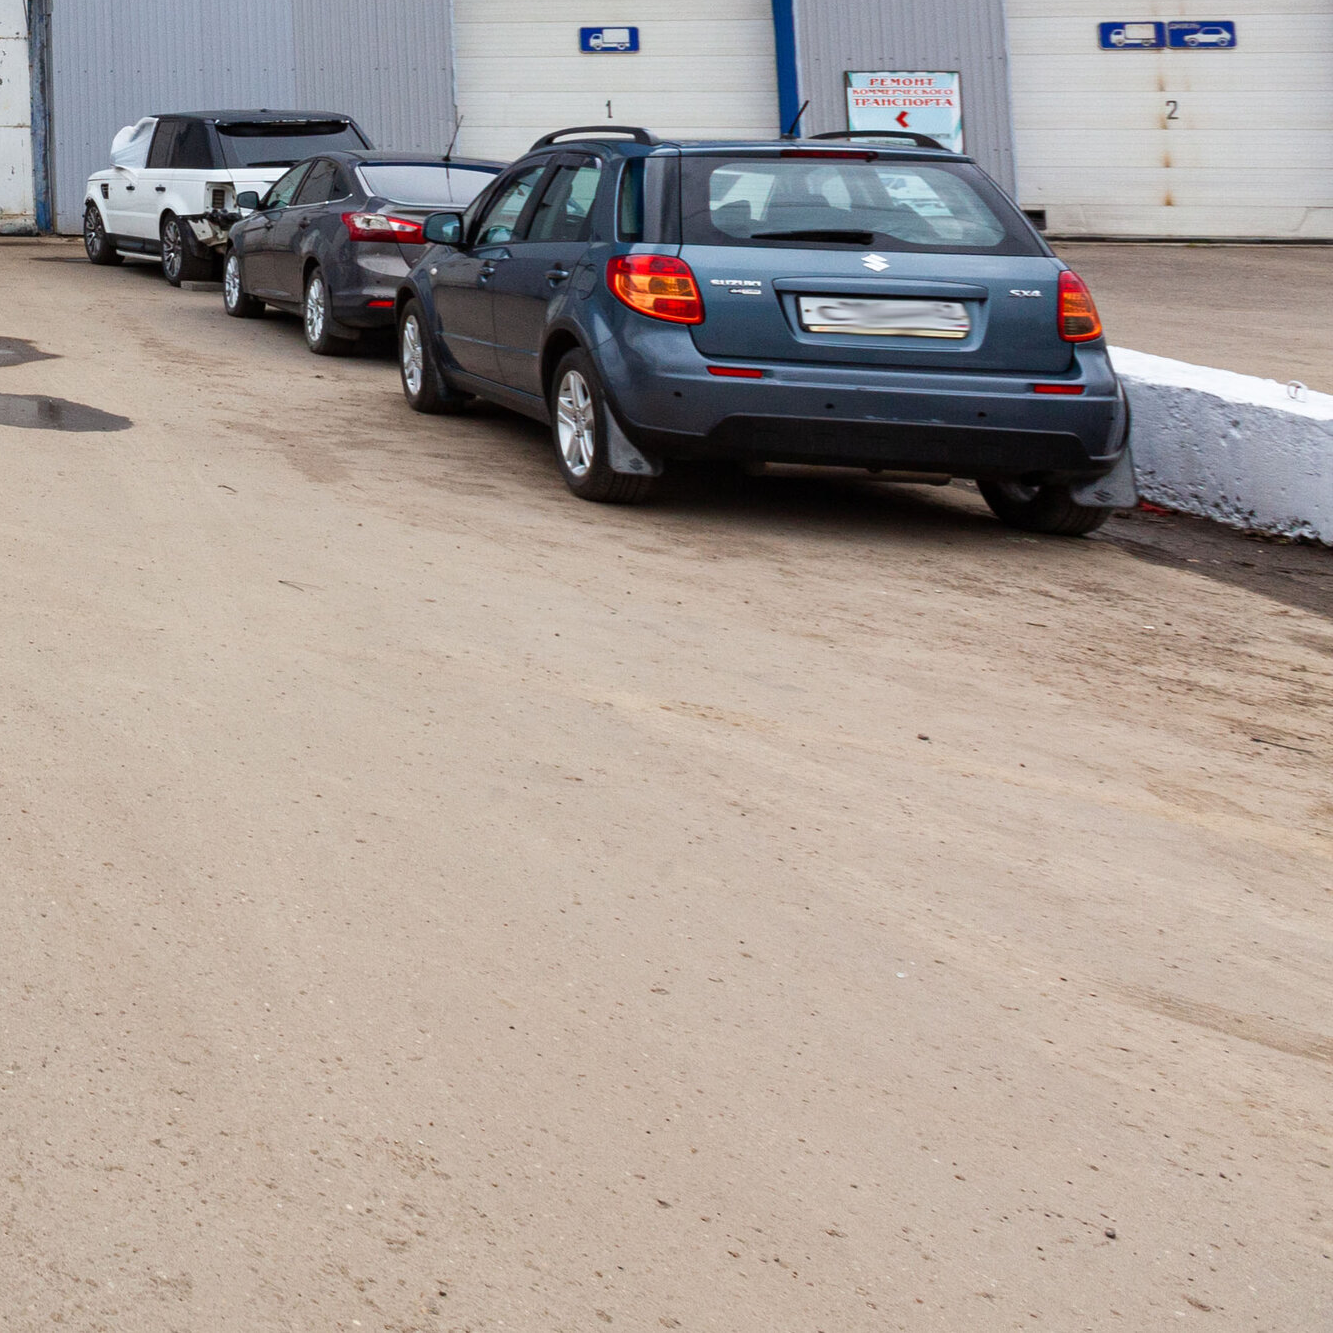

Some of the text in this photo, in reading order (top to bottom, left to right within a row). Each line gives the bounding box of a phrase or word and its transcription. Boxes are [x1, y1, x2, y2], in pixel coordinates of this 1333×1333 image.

[869, 78, 935, 87] РЕМОНТ
[852, 88, 954, 96] КОММЕРЧЕСКОГО
[853, 98, 954, 107] ТРАНСПОРТА
[605, 99, 614, 119] 1
[1165, 100, 1179, 119] 2
[1008, 289, 1043, 298] SX4
